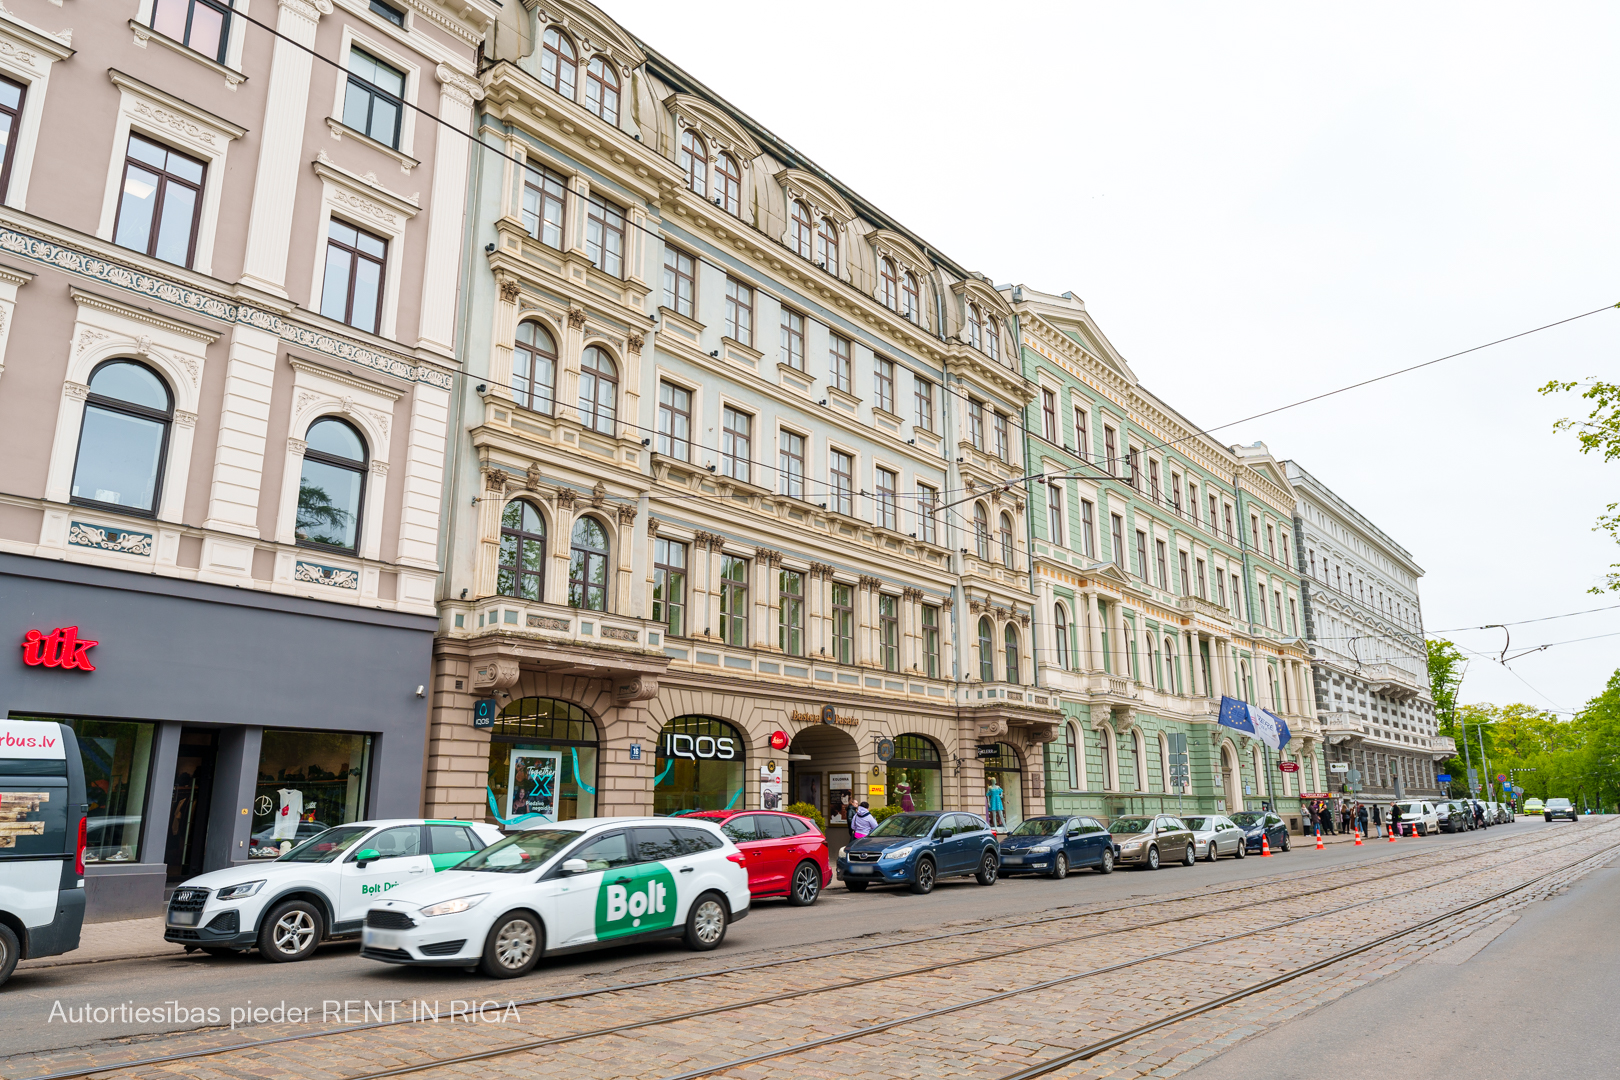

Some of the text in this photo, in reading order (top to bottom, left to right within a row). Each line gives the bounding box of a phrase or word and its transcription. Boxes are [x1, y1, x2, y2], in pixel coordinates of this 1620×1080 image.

[21, 626, 99, 671] itk
[475, 717, 490, 726] IQOS
[667, 733, 735, 761] IQOS
[361, 884, 381, 896] Bolt
[606, 879, 667, 927] Bolt
